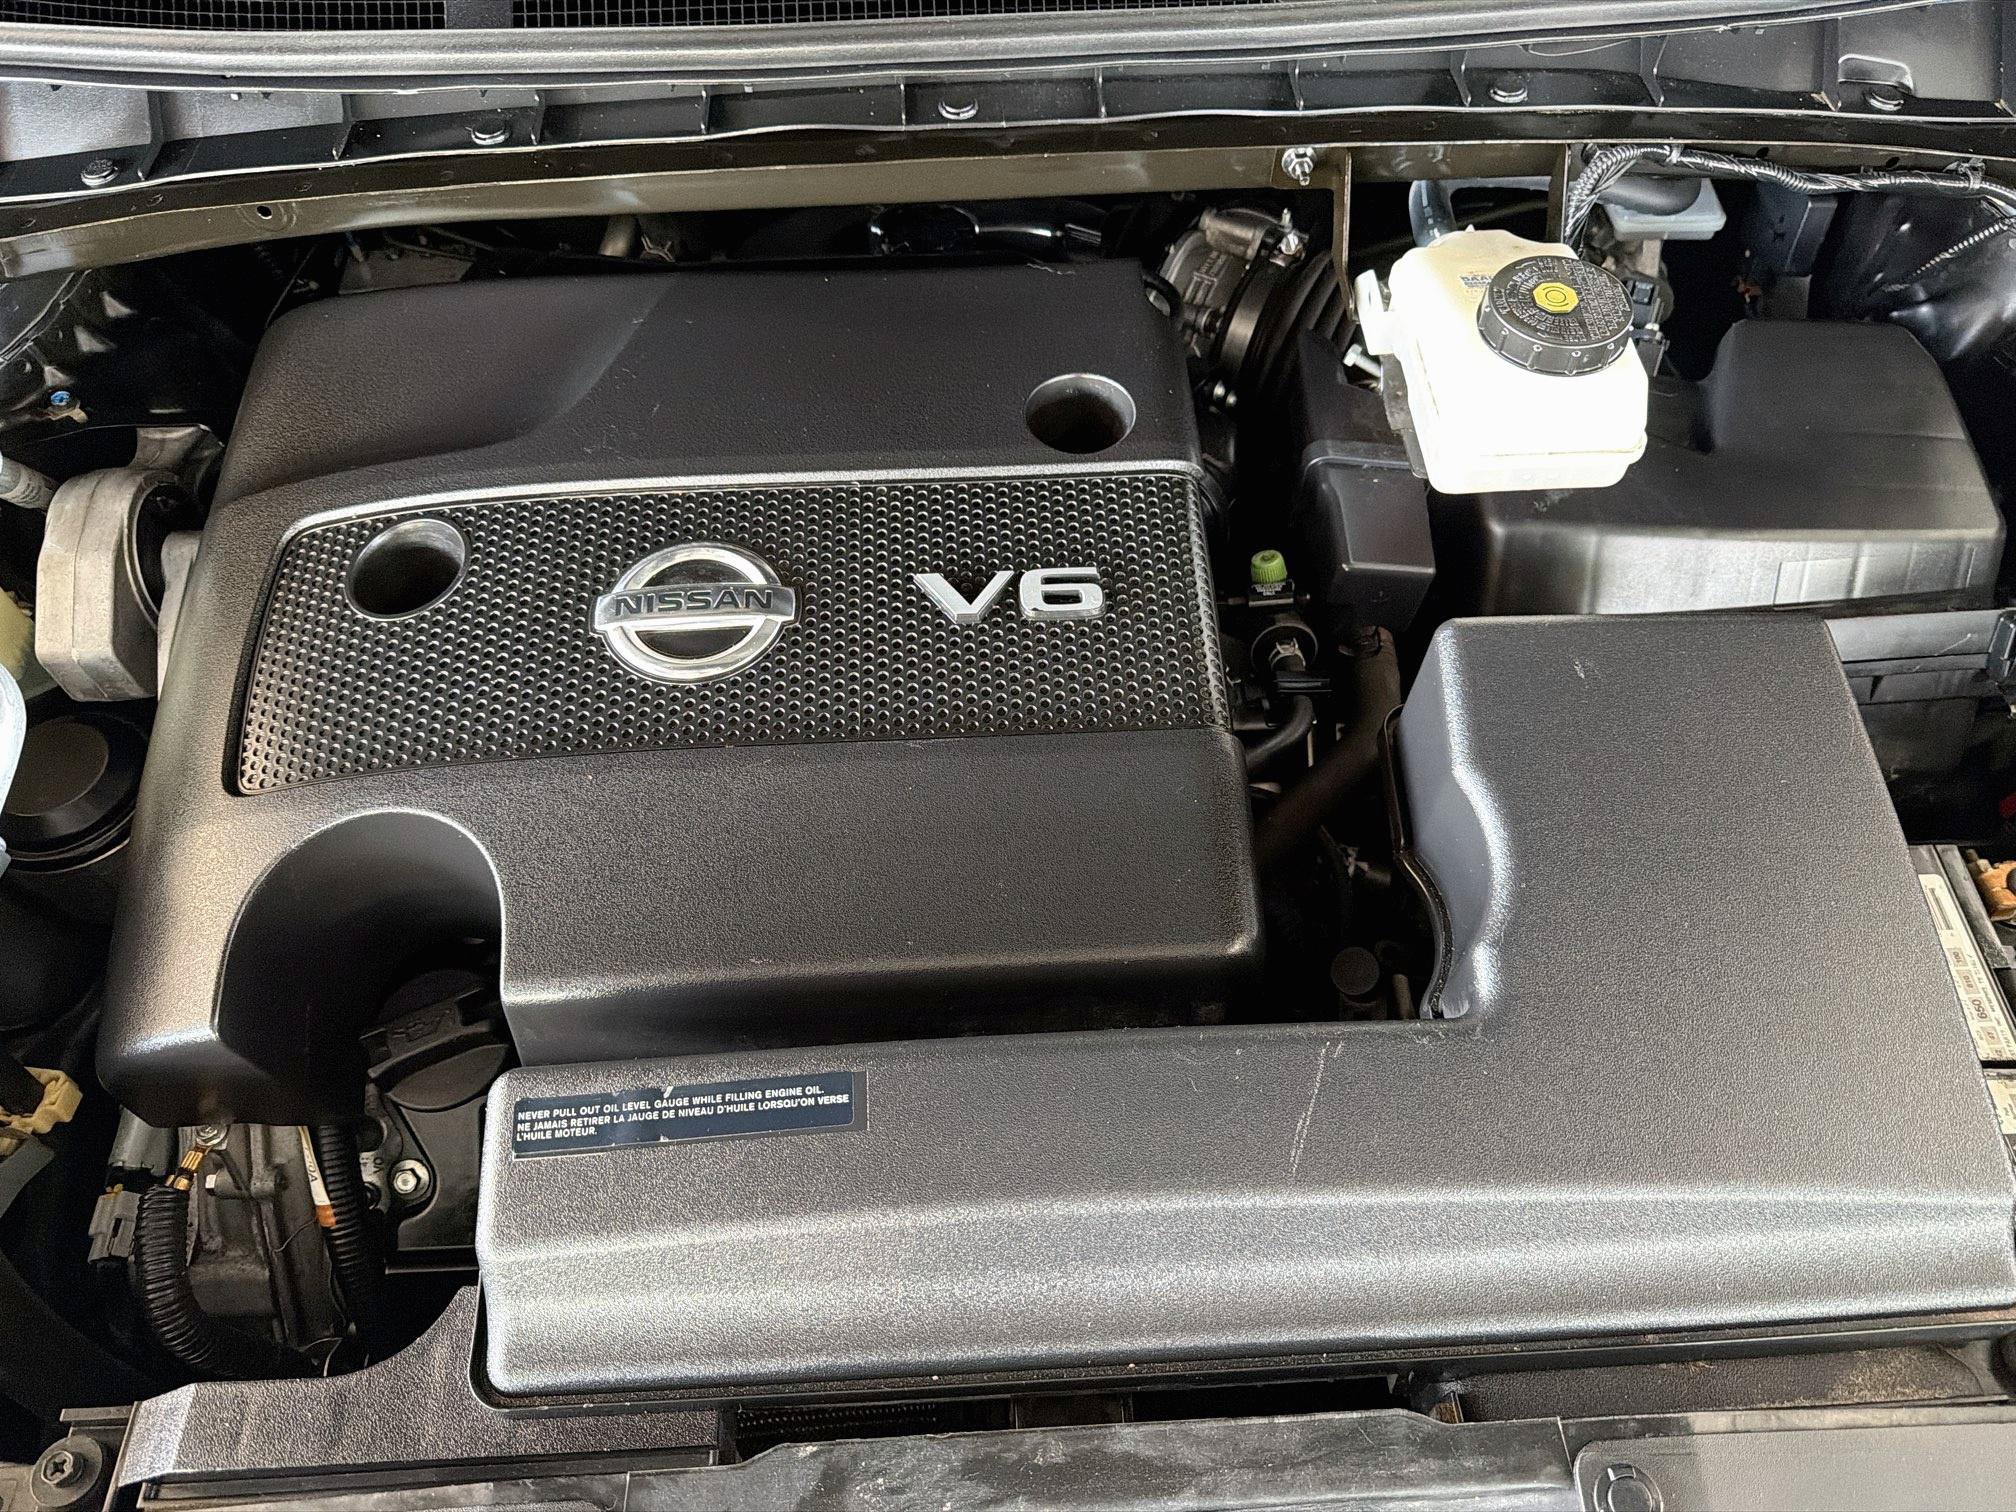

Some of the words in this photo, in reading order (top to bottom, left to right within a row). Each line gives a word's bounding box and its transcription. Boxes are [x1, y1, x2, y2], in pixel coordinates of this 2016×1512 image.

[615, 588, 773, 616] NISSAN
[913, 566, 1105, 624] V6
[1971, 998, 1988, 1019] 650
[517, 1122, 531, 1132] NE
[532, 1119, 568, 1130] JAMAIS
[570, 1115, 611, 1127] RETIRER
[613, 1114, 625, 1124] LA
[627, 1110, 659, 1122] JAUGE
[662, 1109, 676, 1119] DE
[678, 1106, 714, 1117] NIVEAU
[716, 1102, 755, 1114] D'HUILE
[758, 1097, 815, 1111] LORSQU'ON
[817, 1093, 850, 1105] VERSE
[518, 1110, 550, 1120] NEVER
[552, 1108, 577, 1118] PULL
[579, 1105, 600, 1115] OUT
[603, 1103, 620, 1113] OIL
[622, 1101, 651, 1111] LEVEL
[654, 1097, 690, 1108] GAUGE
[692, 1094, 723, 1105] WHILE
[725, 1091, 762, 1102] FILLING
[765, 1087, 803, 1098] ENGINE
[805, 1085, 825, 1095] OIL.
[516, 1129, 552, 1142] L'HUILE
[554, 1127, 598, 1139] MOTEUR.
